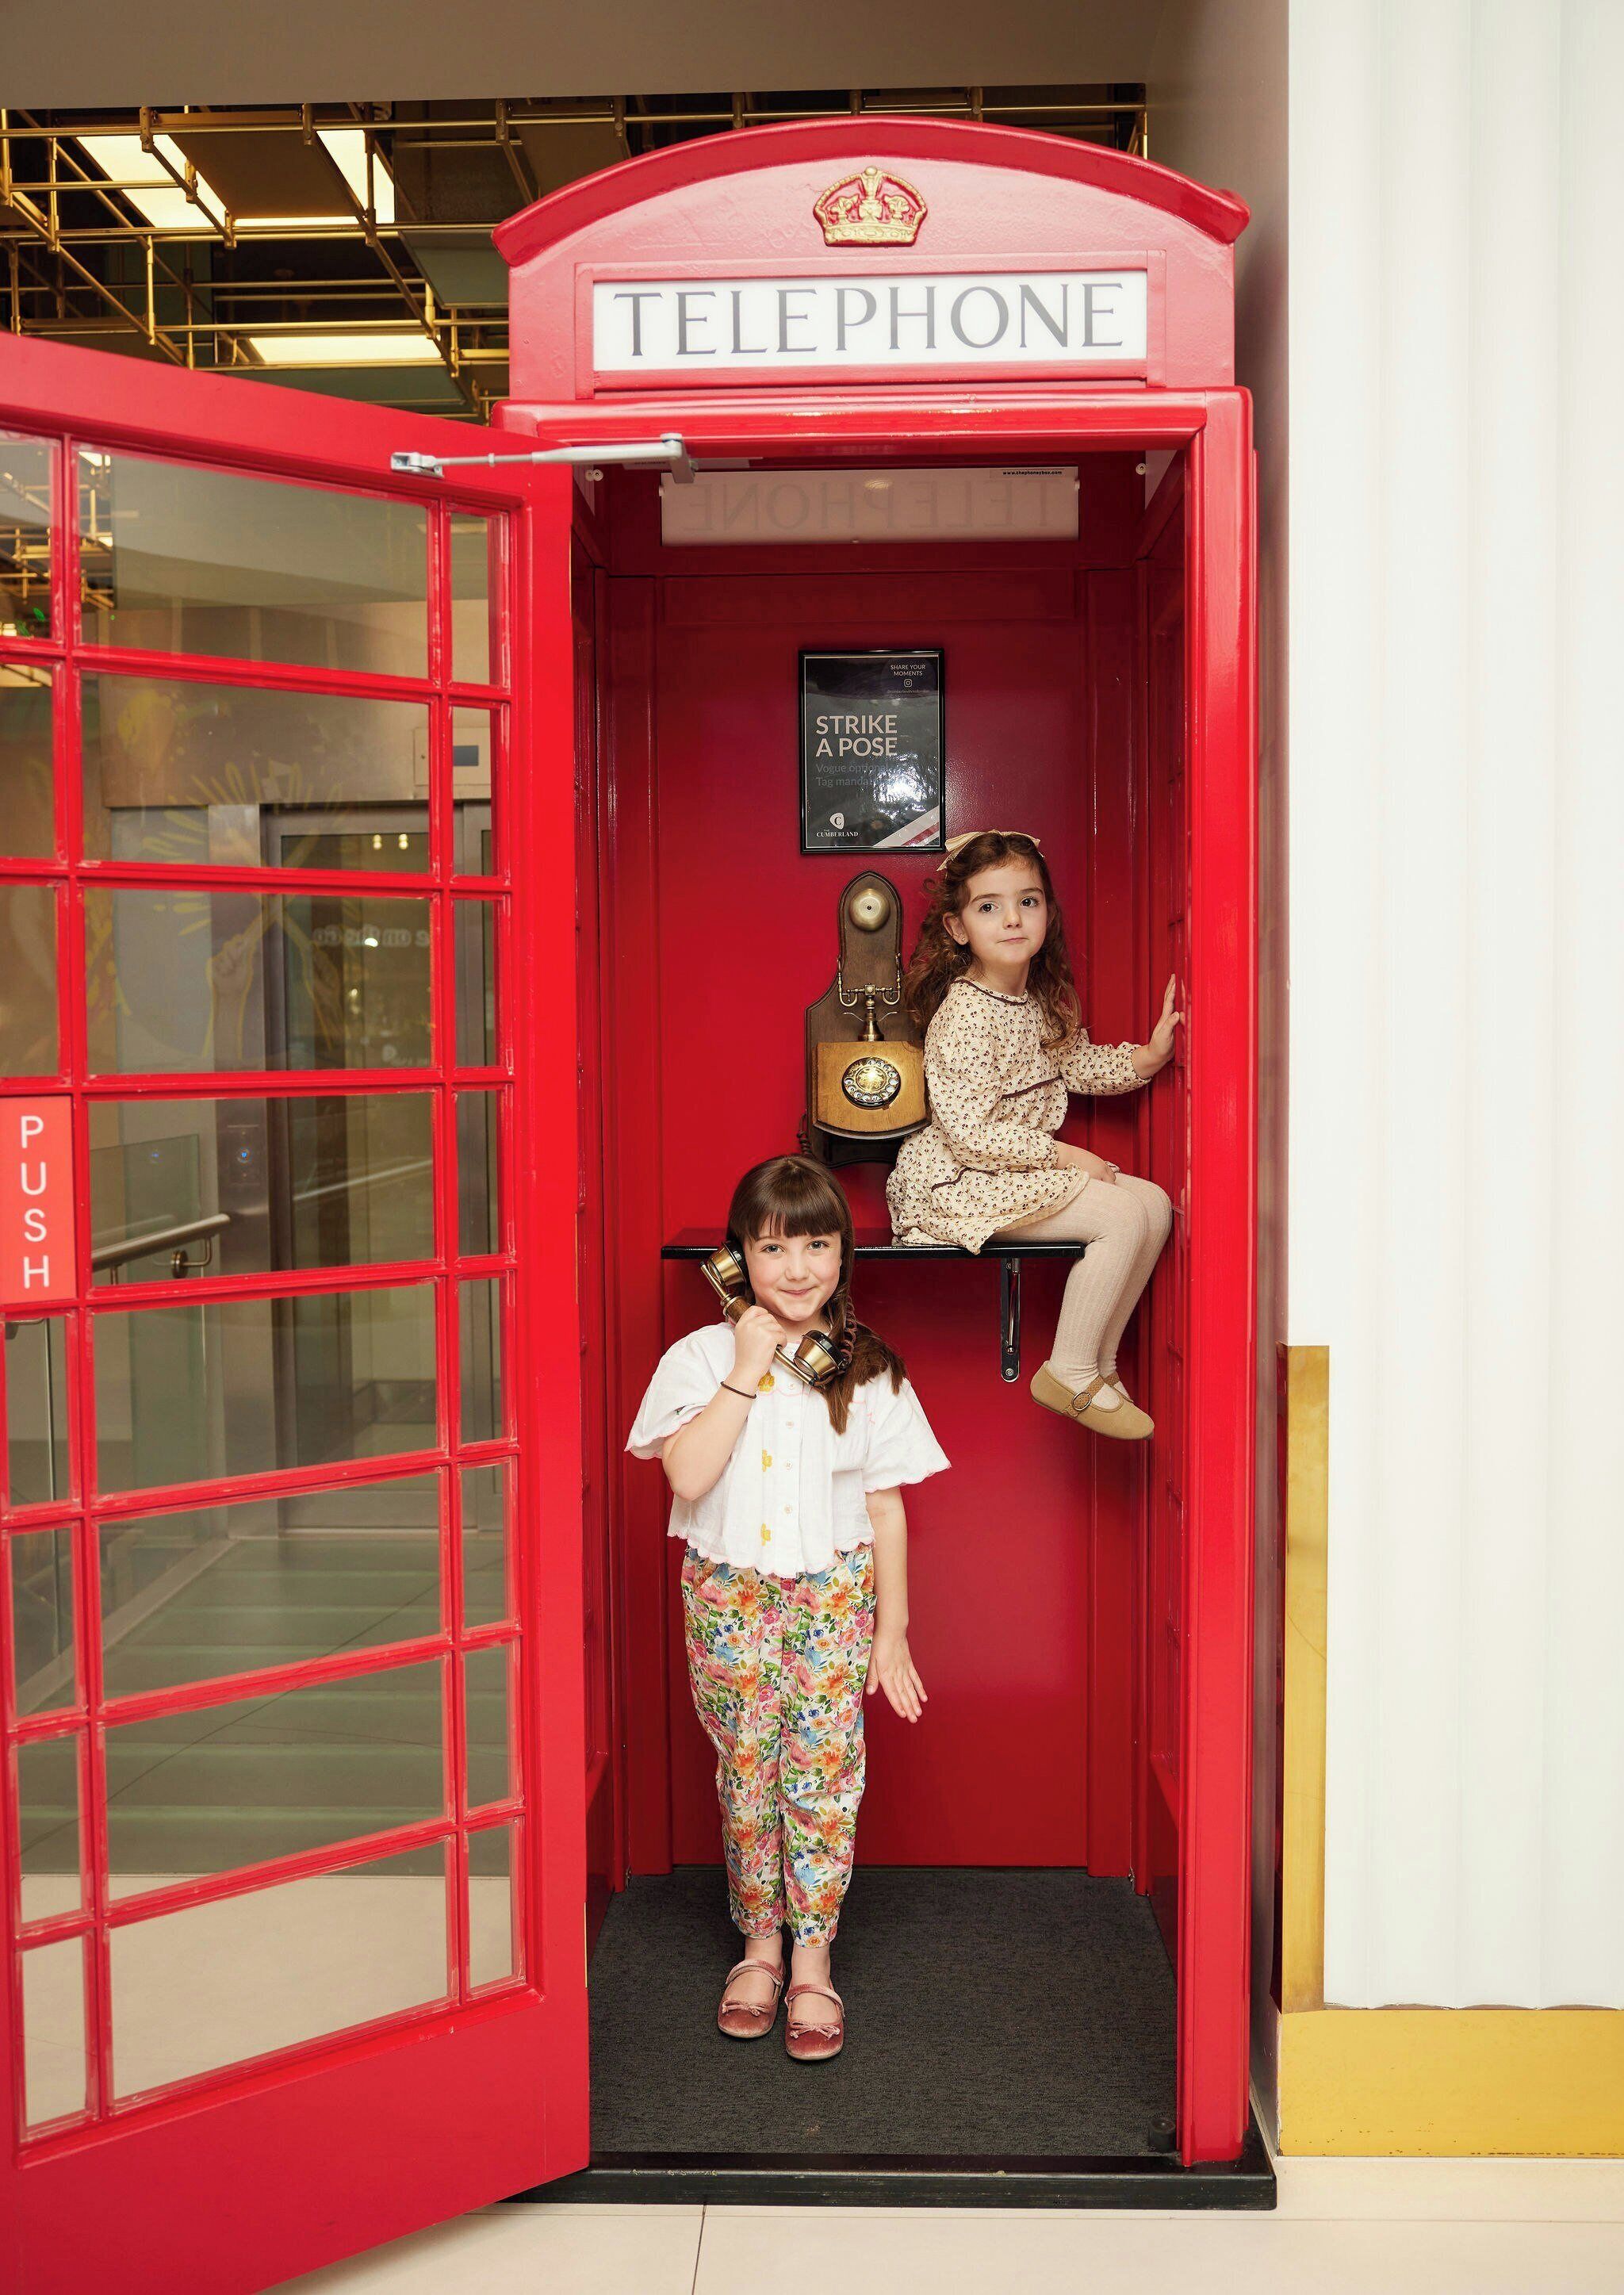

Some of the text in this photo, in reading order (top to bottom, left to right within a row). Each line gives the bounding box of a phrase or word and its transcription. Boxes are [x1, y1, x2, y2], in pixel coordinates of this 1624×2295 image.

[613, 282, 1124, 356] TELEPHONE
[815, 715, 898, 734] STRIKE
[815, 737, 898, 757] A POSE
[815, 764, 847, 775] Vogue
[815, 776, 833, 787] Tag
[21, 1115, 50, 1289] PUSH
